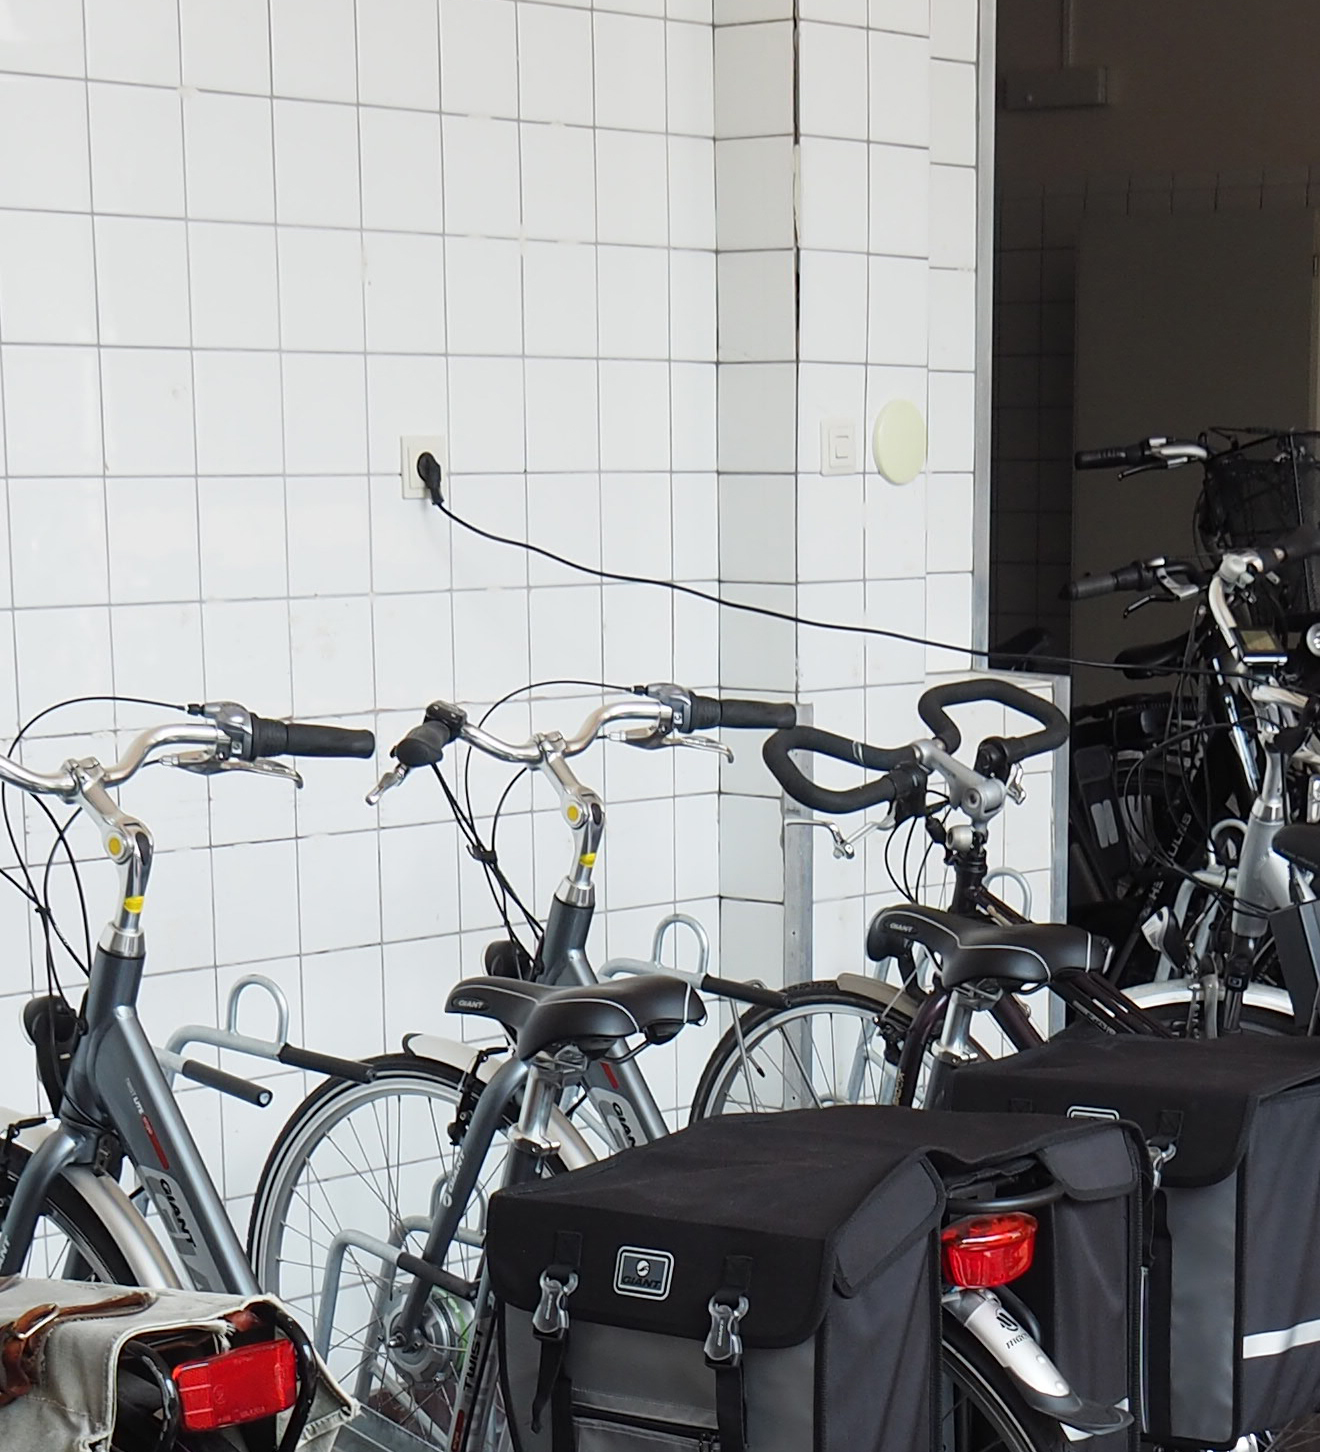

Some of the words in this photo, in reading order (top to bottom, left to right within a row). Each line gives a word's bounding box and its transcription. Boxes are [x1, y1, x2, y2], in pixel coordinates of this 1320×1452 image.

[889, 922, 914, 933] GIANT
[457, 999, 485, 1009] GIANT
[612, 1101, 637, 1148] GIAN
[448, 1152, 466, 1193] GIANT
[159, 1178, 198, 1249] GIANT
[622, 1275, 662, 1290] GIANT
[463, 1328, 484, 1393] TWIST
